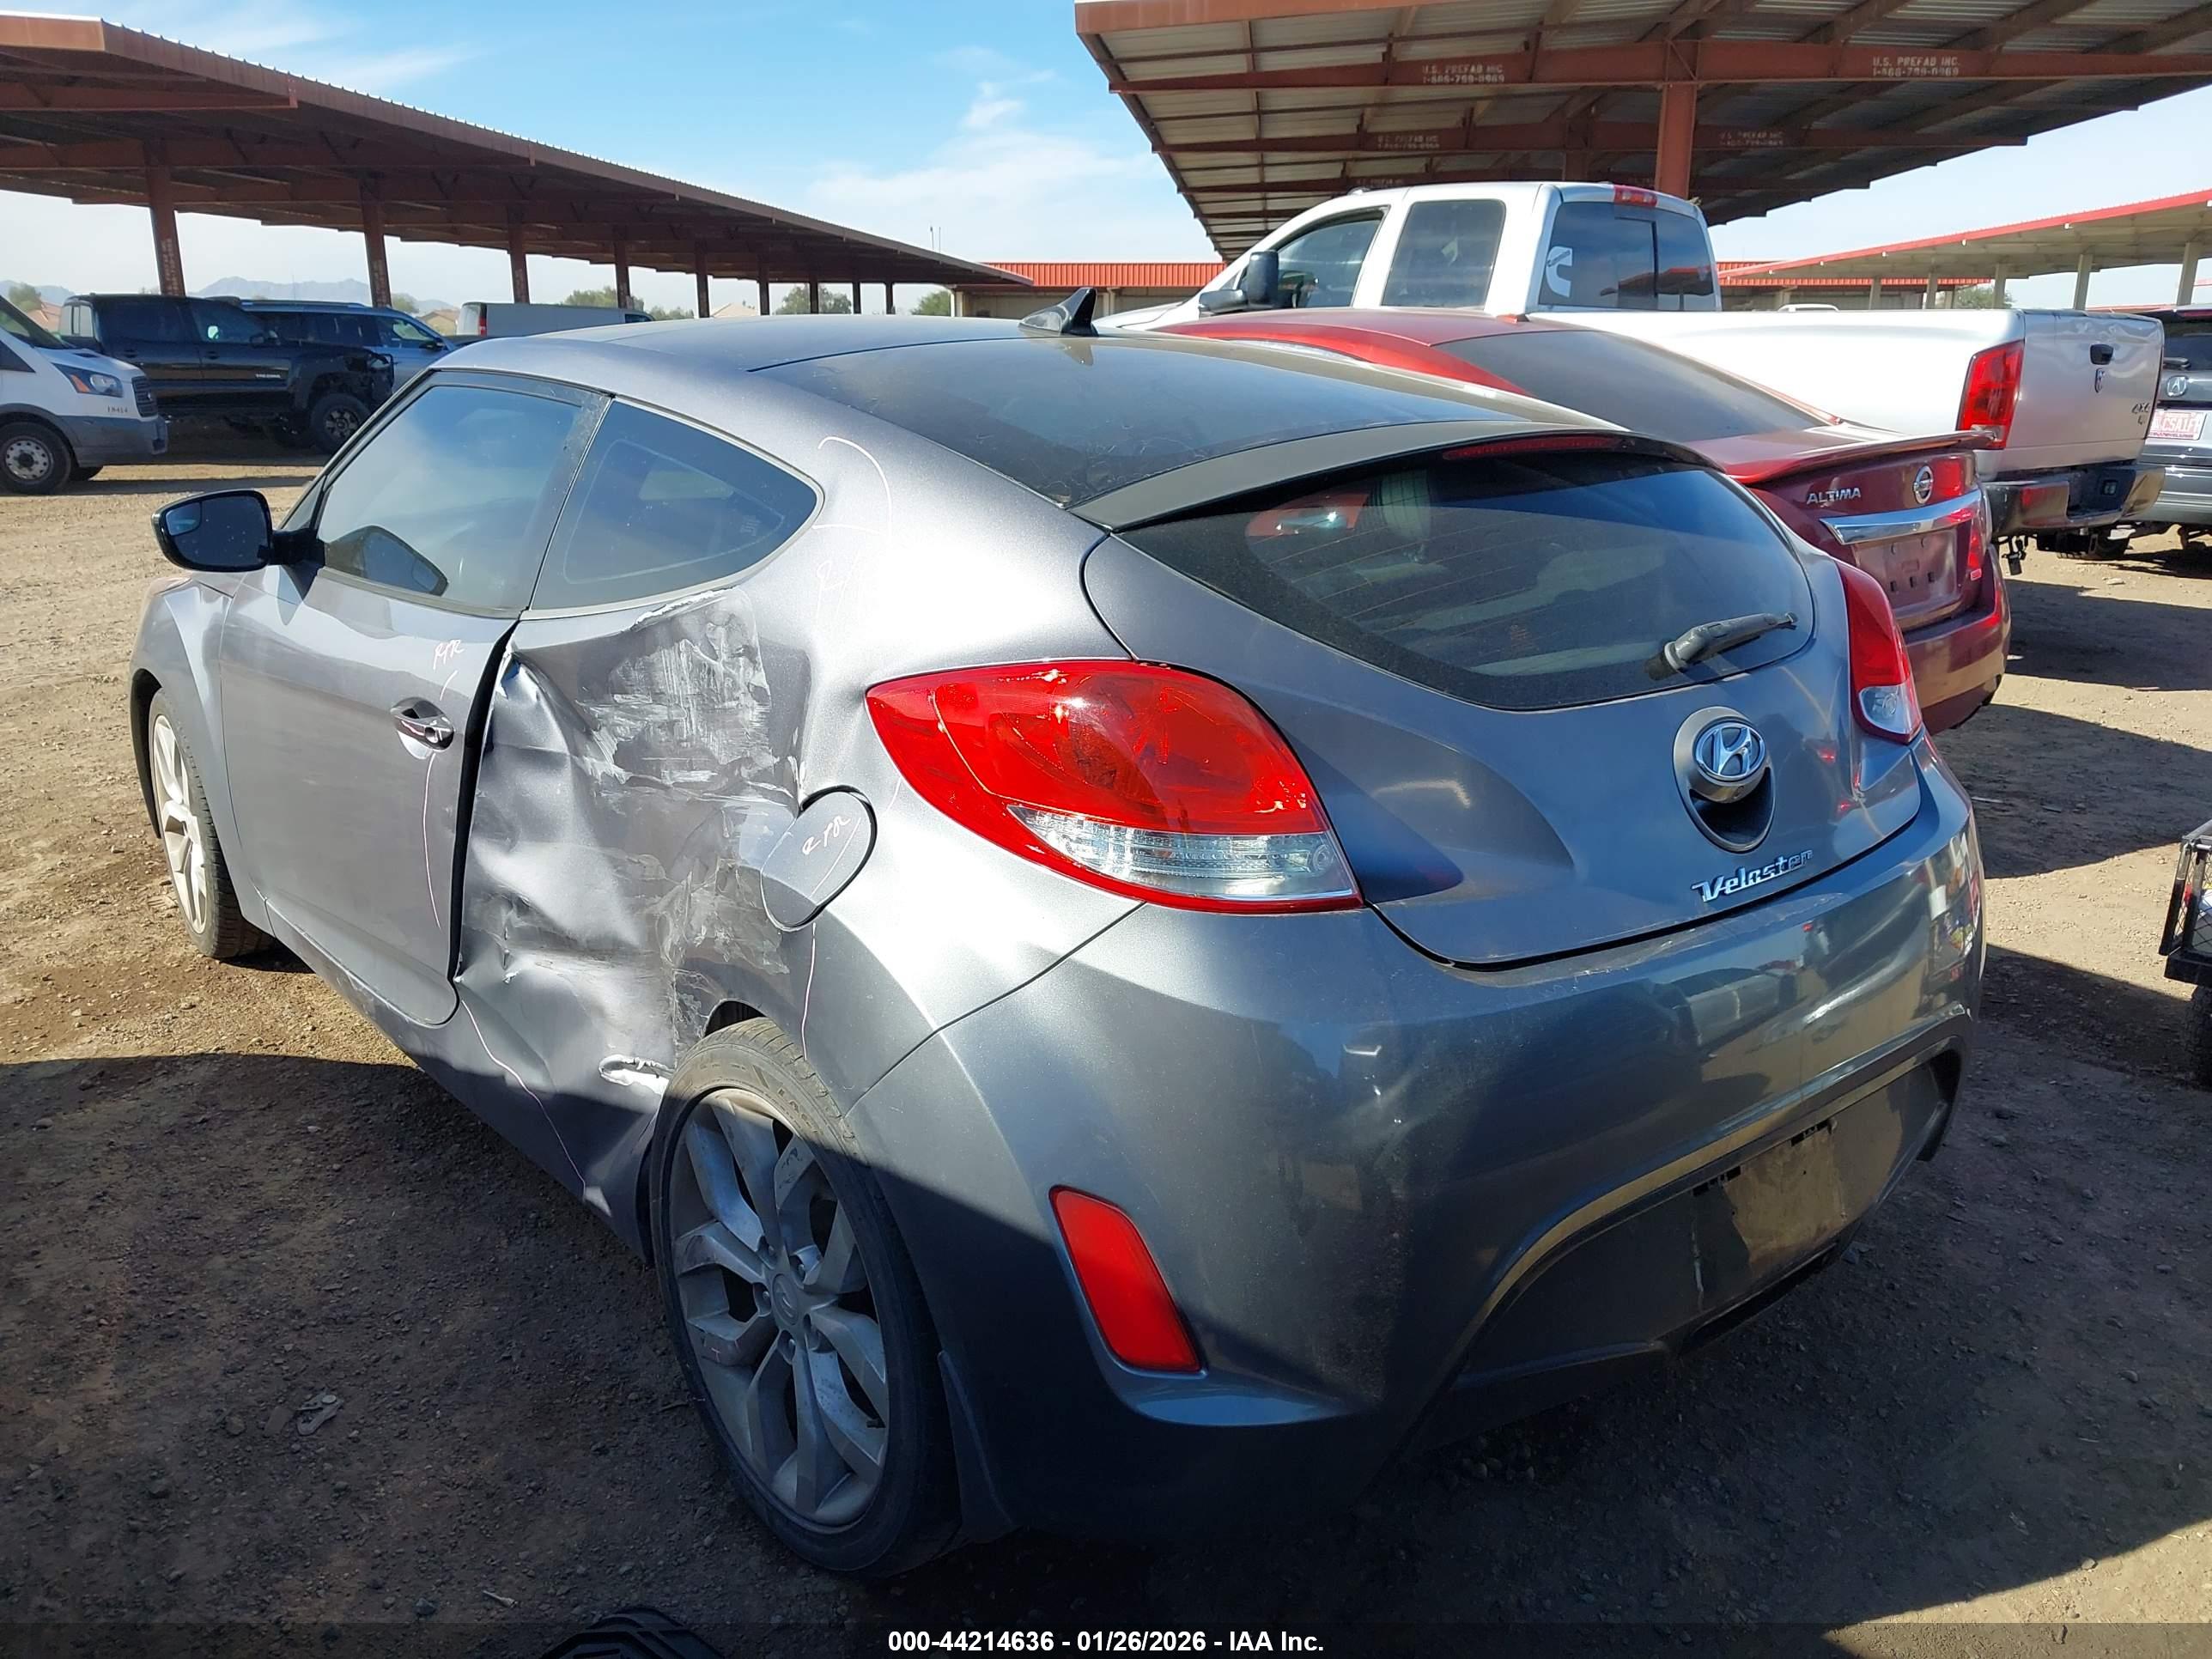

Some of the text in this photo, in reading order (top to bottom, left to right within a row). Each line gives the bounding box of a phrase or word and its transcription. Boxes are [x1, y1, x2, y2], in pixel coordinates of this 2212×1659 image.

[1873, 57, 1893, 67] U.S.
[1897, 56, 1937, 67] PREFAB
[1806, 487, 1862, 505] ALTIMA
[1692, 849, 1814, 902] Veloster
